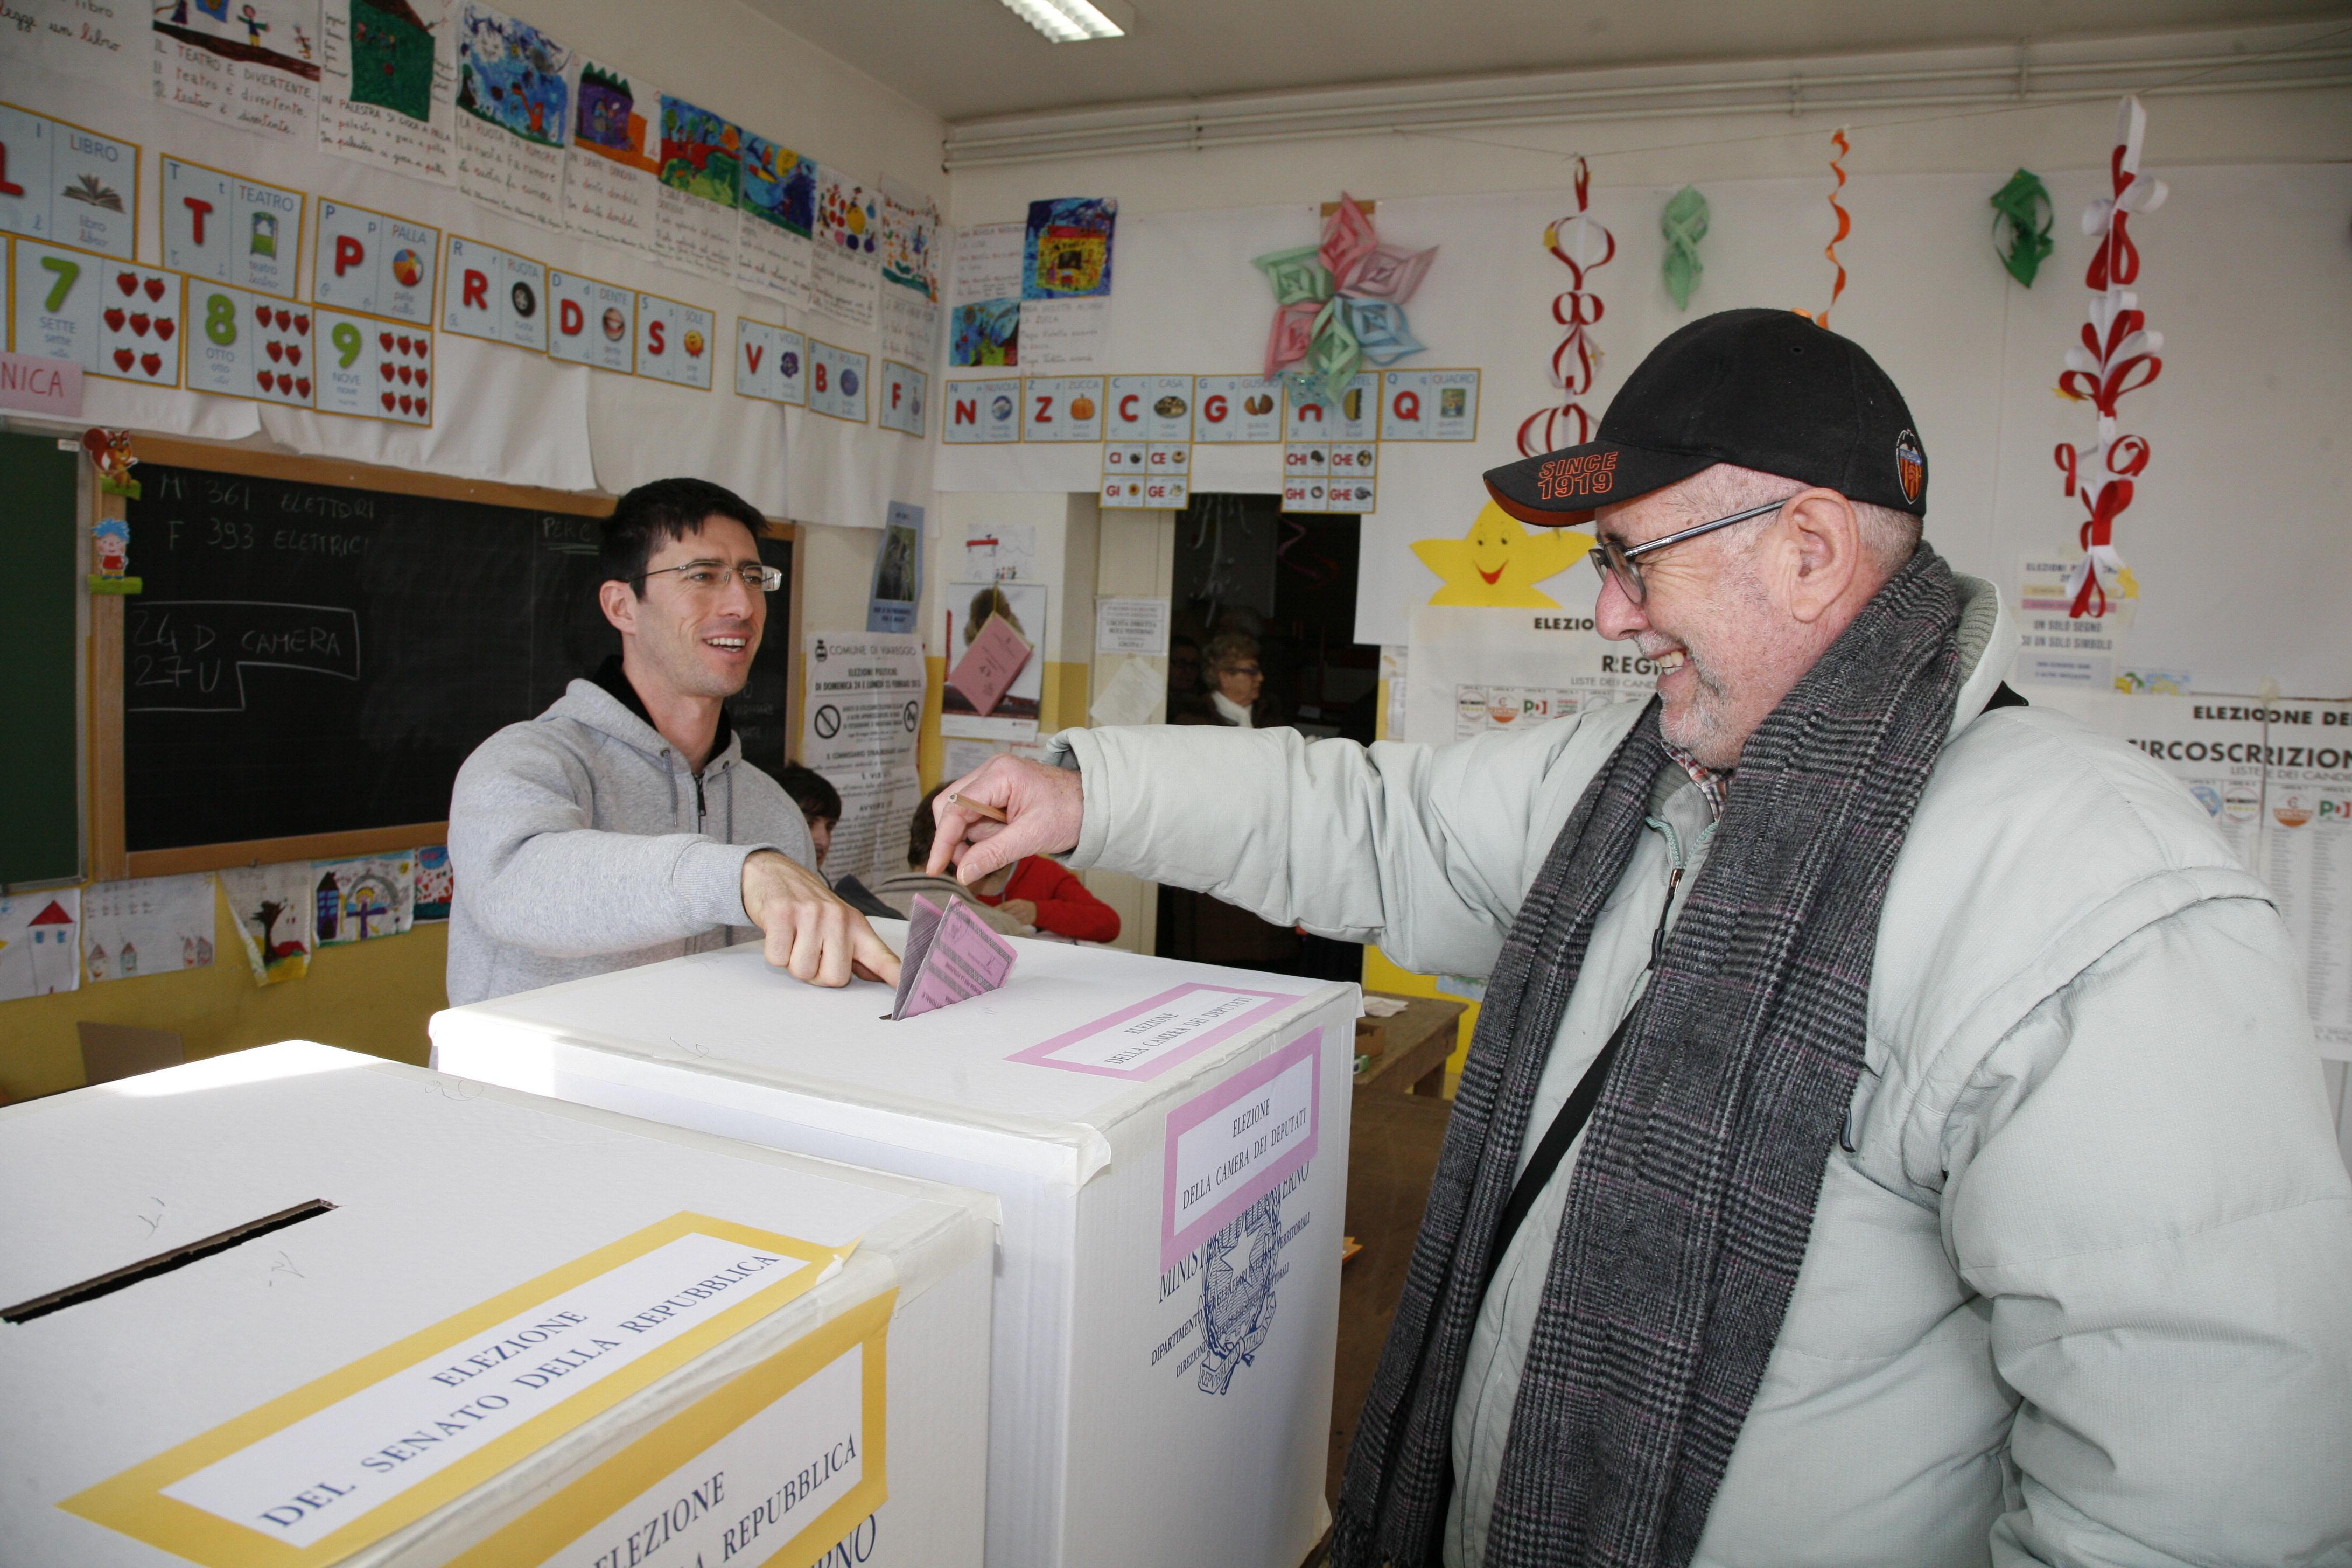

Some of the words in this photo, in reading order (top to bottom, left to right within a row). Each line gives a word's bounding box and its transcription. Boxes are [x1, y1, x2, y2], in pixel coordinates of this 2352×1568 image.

[80, 22, 122, 52] libro
[177, 44, 221, 72] TEATRO
[69, 133, 120, 163] LIBRO
[0, 141, 24, 198] L
[169, 162, 180, 180] T
[218, 181, 225, 194] t
[239, 184, 295, 213] TEATRO
[79, 214, 107, 233] libro
[183, 196, 214, 246] T
[325, 204, 336, 220] P
[367, 221, 377, 234] p
[391, 223, 428, 246] PALLA
[334, 234, 365, 279] P
[453, 240, 464, 257] R
[249, 260, 278, 275] teatro
[507, 257, 540, 279] RUOTA
[40, 255, 81, 313] 7
[461, 267, 489, 313] R
[552, 272, 562, 288] D
[599, 288, 628, 306] DENTE
[642, 296, 649, 311] S
[39, 316, 78, 335] SETTE
[205, 293, 237, 346] 8
[559, 297, 585, 338] D
[684, 310, 704, 325] SOLE
[331, 321, 362, 370] 9
[647, 319, 667, 358] S
[205, 347, 235, 363] OTTO
[744, 341, 765, 376] V
[0, 361, 65, 400] NICA
[332, 372, 361, 386] NOVE
[815, 361, 828, 395] B
[949, 383, 959, 394] N
[985, 382, 1019, 393] NUVOLA
[1028, 380, 1035, 391] Z
[1068, 379, 1100, 390] ZUCCA
[1112, 378, 1121, 389] C
[1158, 379, 1184, 389] CASA
[1199, 378, 1208, 389] G
[1387, 373, 1398, 385] Q
[1432, 373, 1475, 384] QUADRO
[891, 381, 902, 411] F
[1393, 390, 1420, 422] Q
[954, 398, 977, 426] N
[1034, 396, 1054, 424] Z
[1118, 394, 1140, 424] C
[1204, 394, 1229, 424] G
[1109, 451, 1122, 464] CI
[1151, 452, 1167, 465] CE
[1286, 453, 1307, 466] CHI
[1332, 453, 1353, 466] CHE
[1539, 451, 1620, 479] SINCE
[1107, 485, 1121, 498] GI
[1148, 485, 1165, 498] GE
[1285, 488, 1306, 500] GHI
[1330, 488, 1352, 501] GHE
[1538, 470, 1614, 500] 1919
[208, 480, 251, 512] 361
[280, 492, 375, 520] ELETTORI
[169, 520, 185, 551] F
[207, 517, 254, 551] 393
[273, 529, 370, 558] ELETTRICI
[130, 610, 178, 653] 24
[194, 624, 216, 652] D
[241, 625, 341, 657] CAMERA
[1534, 617, 1595, 631] ELEZIO
[830, 645, 866, 655] COMUNE
[134, 654, 192, 687] 27
[823, 681, 852, 691] DOMENICA
[1103, 1047, 1150, 1065] DELLA
[1142, 1026, 1192, 1047] CAMERA
[1182, 1017, 1210, 1027] DEI
[1201, 996, 1254, 1018] DEPUTATI
[1124, 1012, 1179, 1035] ELEZIONE
[1232, 1098, 1270, 1138] ELEZIONE
[1182, 1173, 1211, 1210] DELLA
[1216, 1146, 1250, 1186] CAMERA
[1254, 1135, 1267, 1159] DEI
[1271, 1107, 1306, 1147] DEPUTATI
[1151, 1308, 1203, 1366] DIPARTIMENTO
[429, 1310, 590, 1389] ELEZIONE
[1176, 1340, 1209, 1378] DIREZIONE
[256, 1482, 358, 1530] DEL
[359, 1393, 510, 1475] SENATO
[512, 1336, 622, 1390] DELLA
[617, 1252, 781, 1336] REPUBBLICA
[722, 1432, 858, 1564] REPUBBLICA
